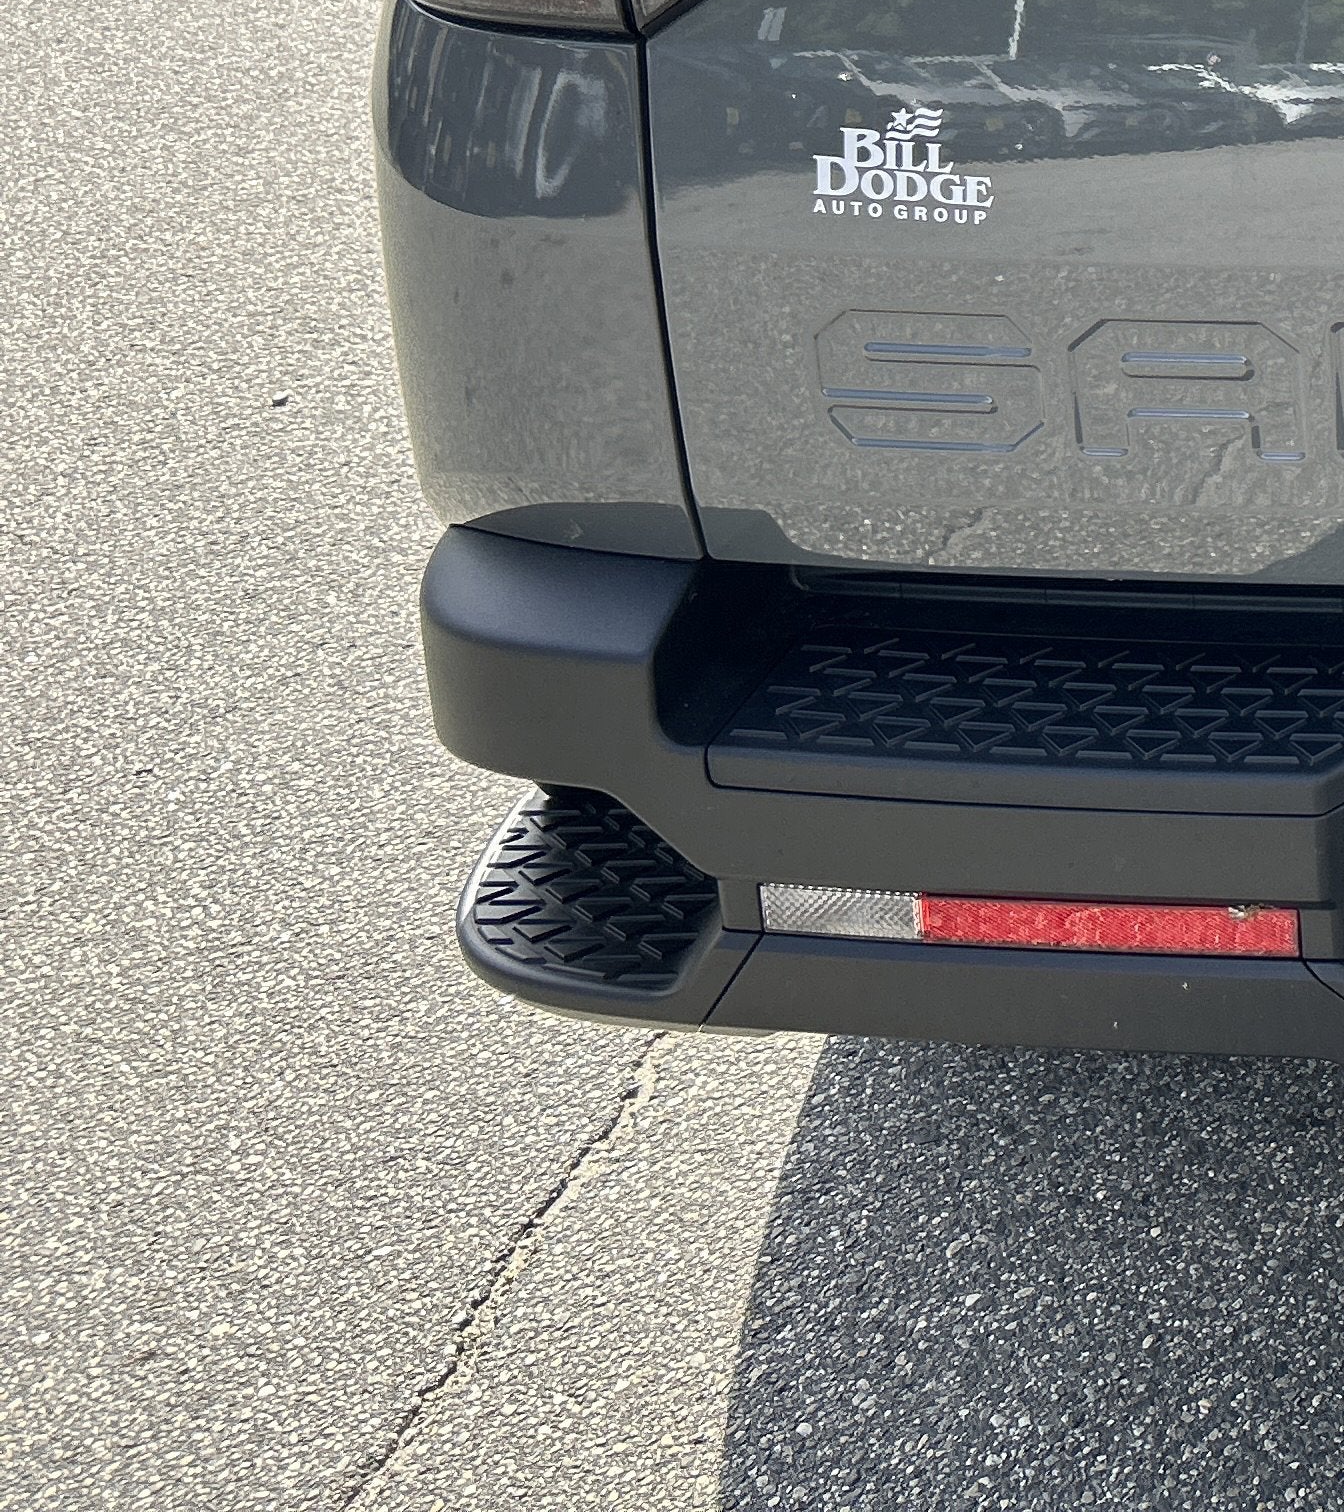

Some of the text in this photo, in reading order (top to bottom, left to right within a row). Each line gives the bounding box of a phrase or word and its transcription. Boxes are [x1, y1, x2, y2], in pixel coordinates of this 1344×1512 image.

[840, 127, 953, 173] BILL
[813, 155, 994, 207] DODGE
[813, 199, 987, 224] AUTO GROUP
